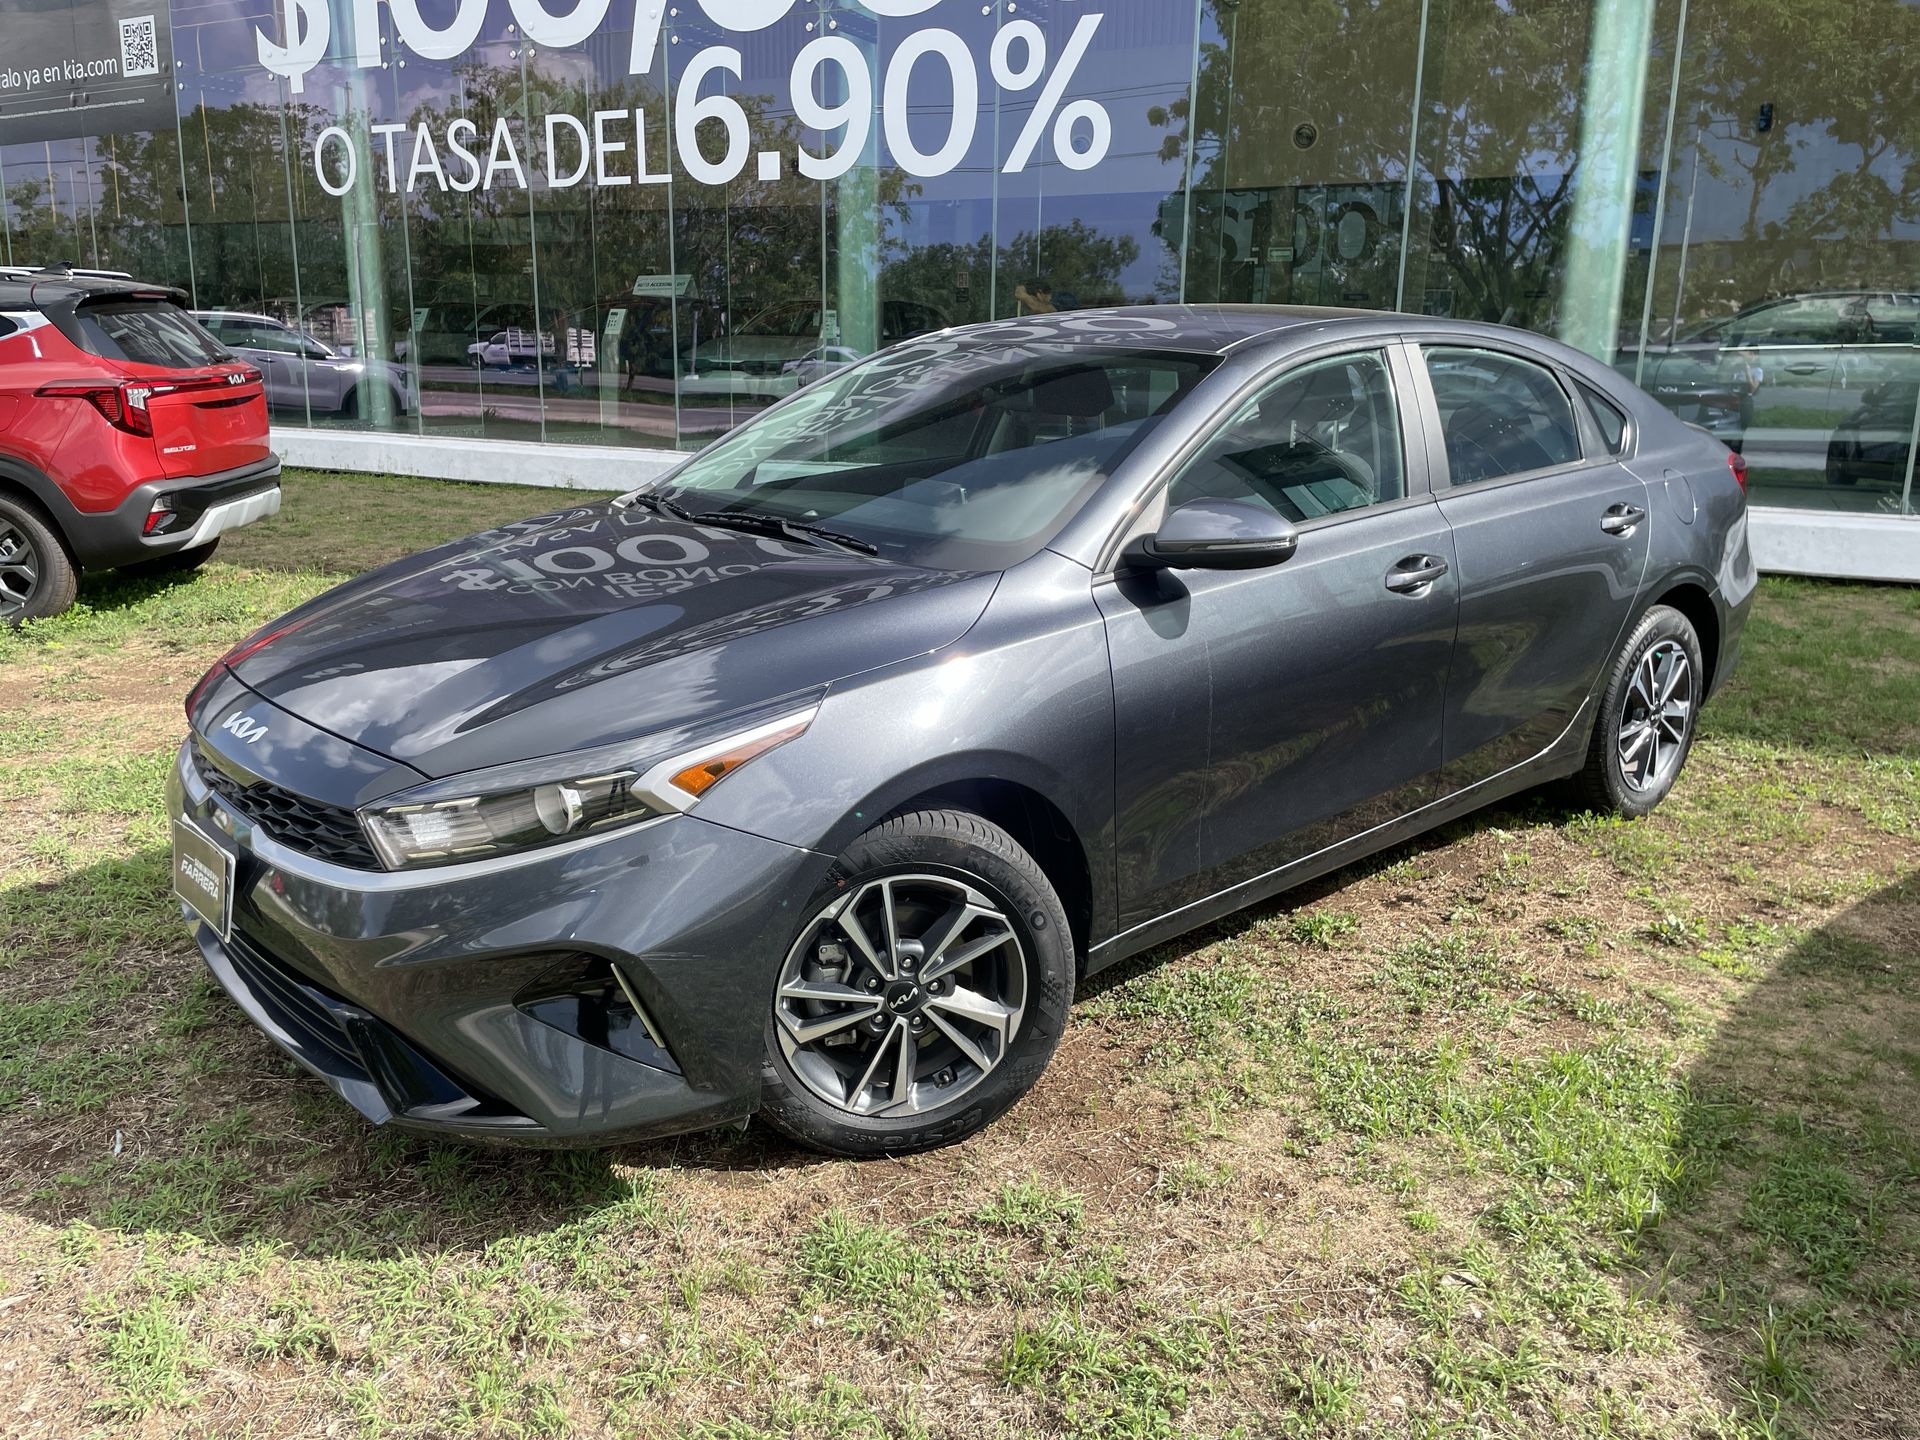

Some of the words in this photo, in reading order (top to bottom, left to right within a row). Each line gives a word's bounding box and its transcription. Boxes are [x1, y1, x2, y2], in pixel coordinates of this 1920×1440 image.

[0, 68, 20, 88] alo
[24, 69, 40, 90] ya
[43, 66, 60, 82] en
[63, 58, 118, 80] kia.com
[315, 126, 357, 196] O
[371, 117, 528, 194] TASA
[544, 108, 673, 188] DEL
[675, 13, 1112, 185] 6.90%
[228, 373, 246, 385] KIA
[222, 710, 269, 744] KIA
[180, 859, 219, 901] FARRERA
[890, 986, 919, 1009] KIA
